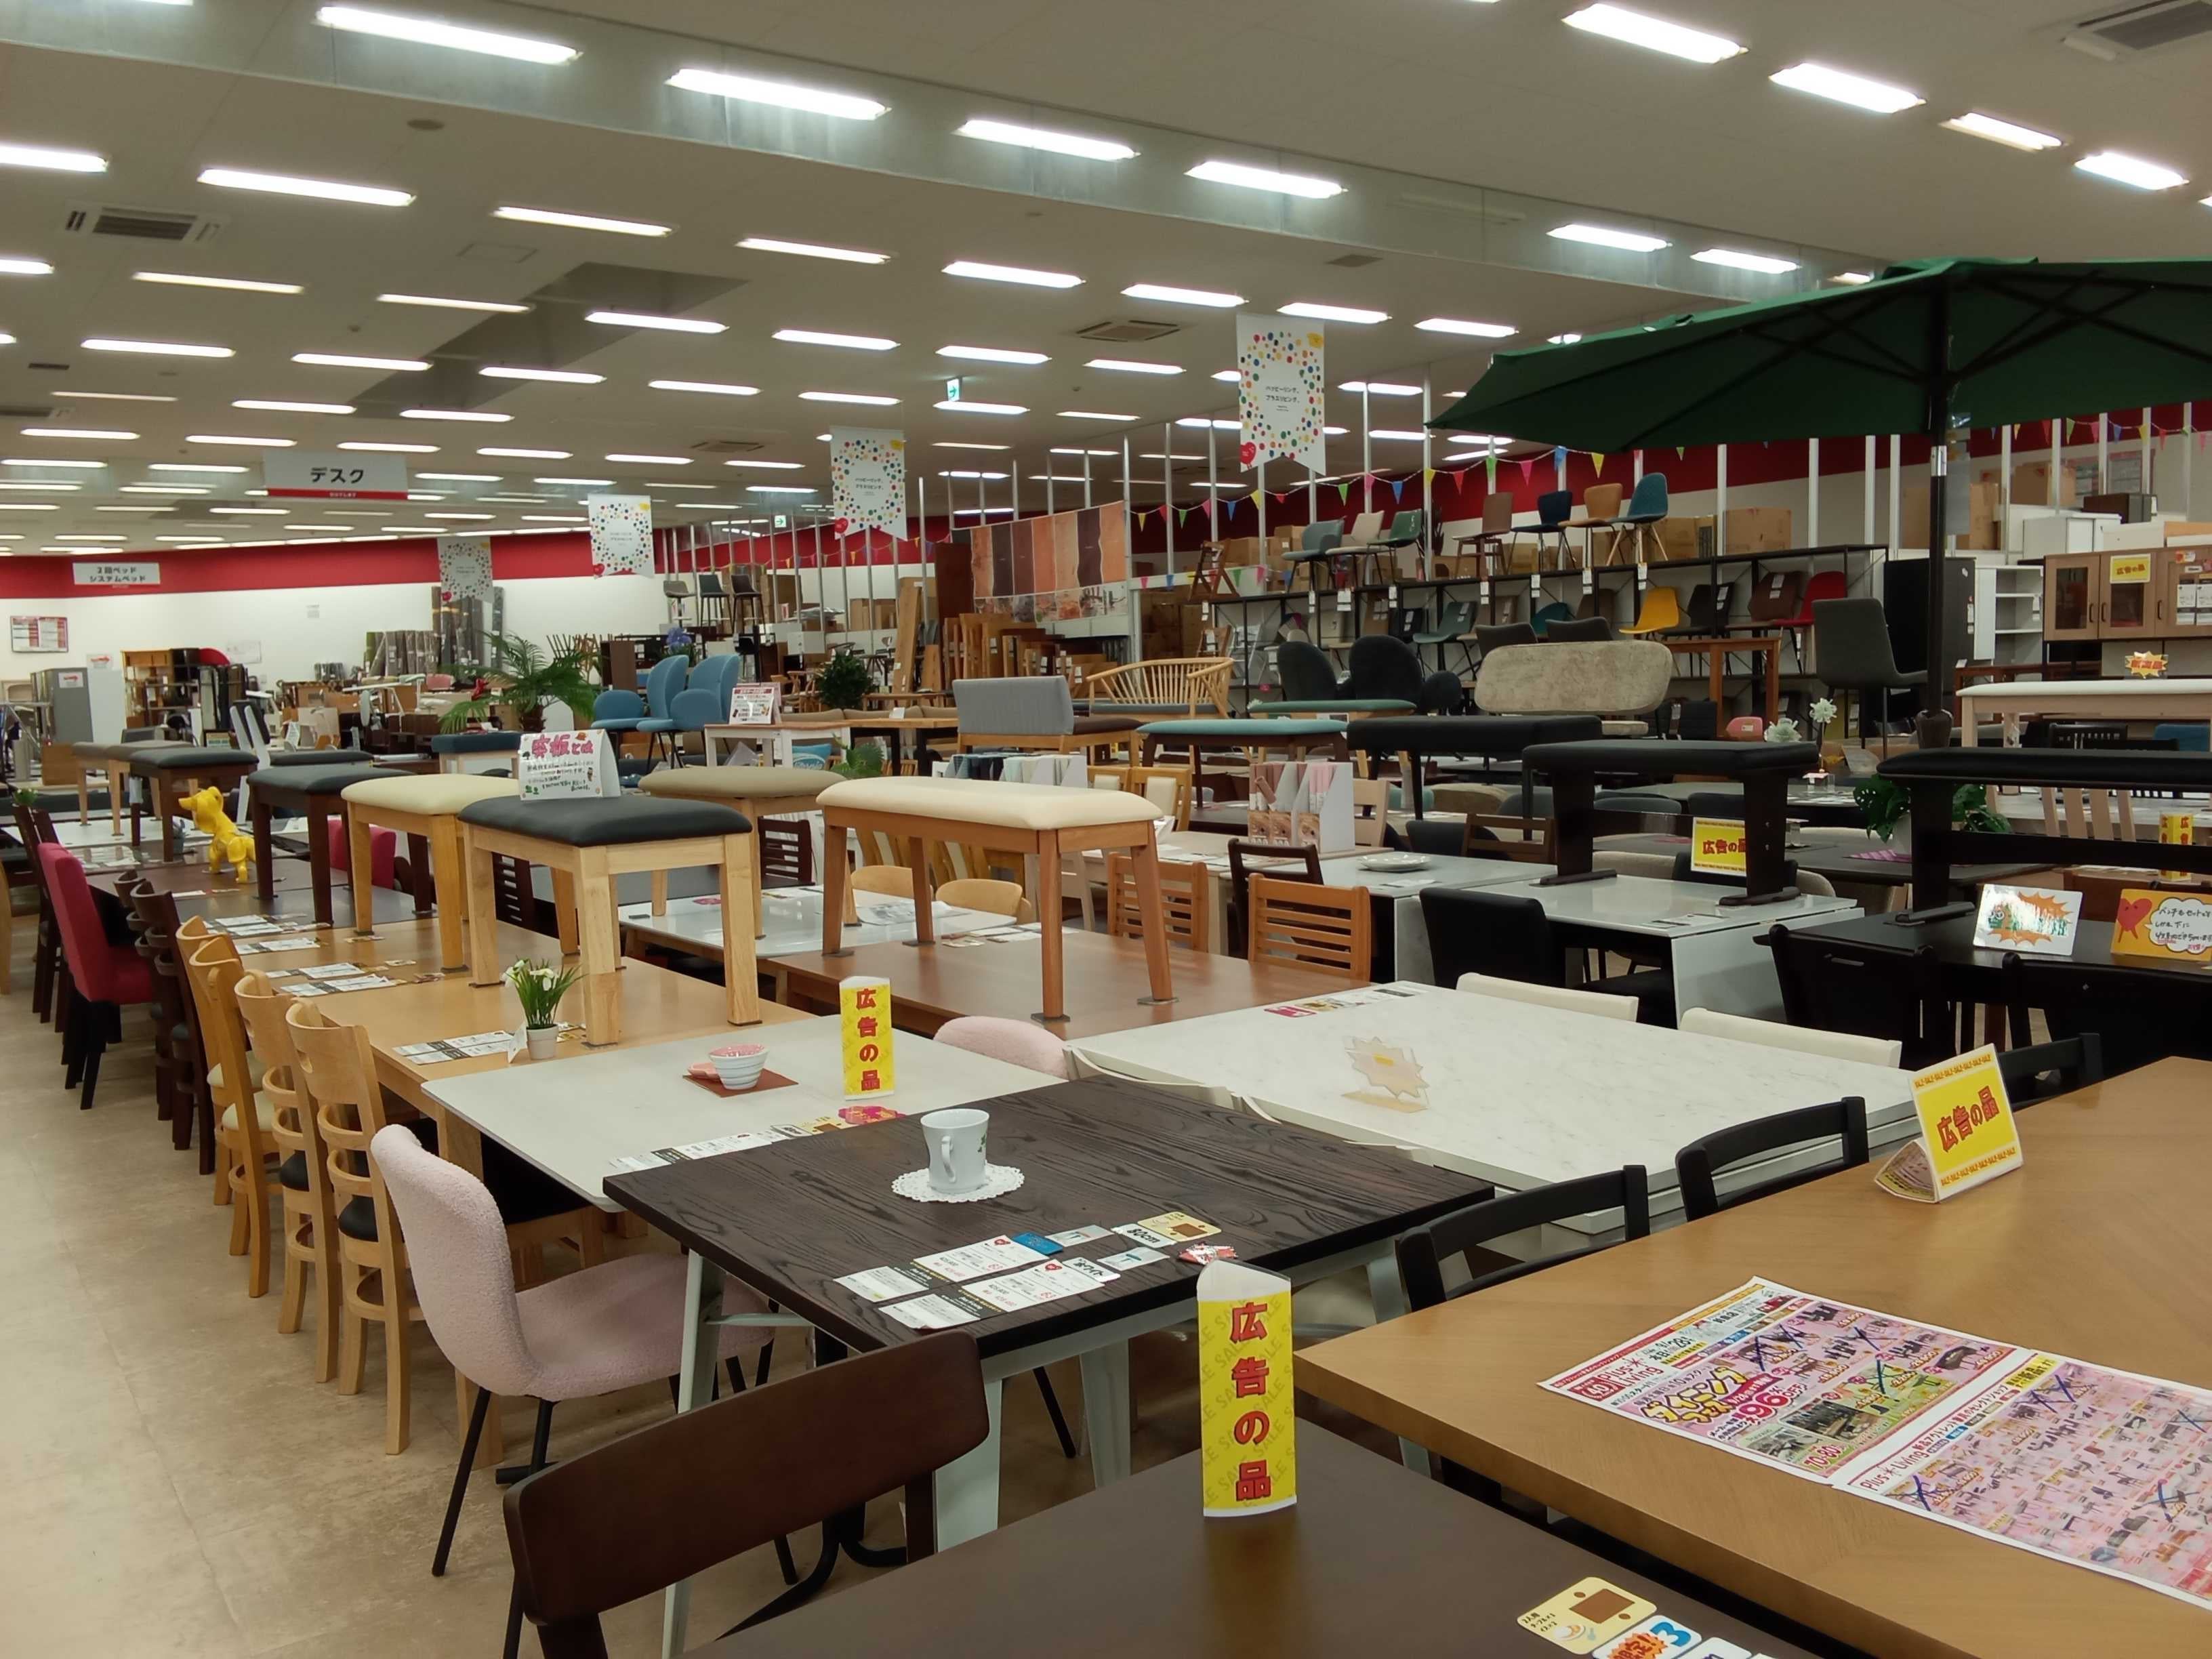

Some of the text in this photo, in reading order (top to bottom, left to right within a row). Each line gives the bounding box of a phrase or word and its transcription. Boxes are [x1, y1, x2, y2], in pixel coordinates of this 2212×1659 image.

[310, 467, 364, 484] デスク
[855, 988, 880, 1091] 広告の品
[1936, 1085, 2000, 1153] 広告の品
[1597, 1362, 1628, 1387] Plus
[1618, 1365, 1664, 1389] Living
[1641, 1366, 1748, 1422] ダイニング
[1229, 1302, 1272, 1502] 広告の品
[1860, 1475, 1889, 1490] Plus
[1891, 1450, 1929, 1472] Living
